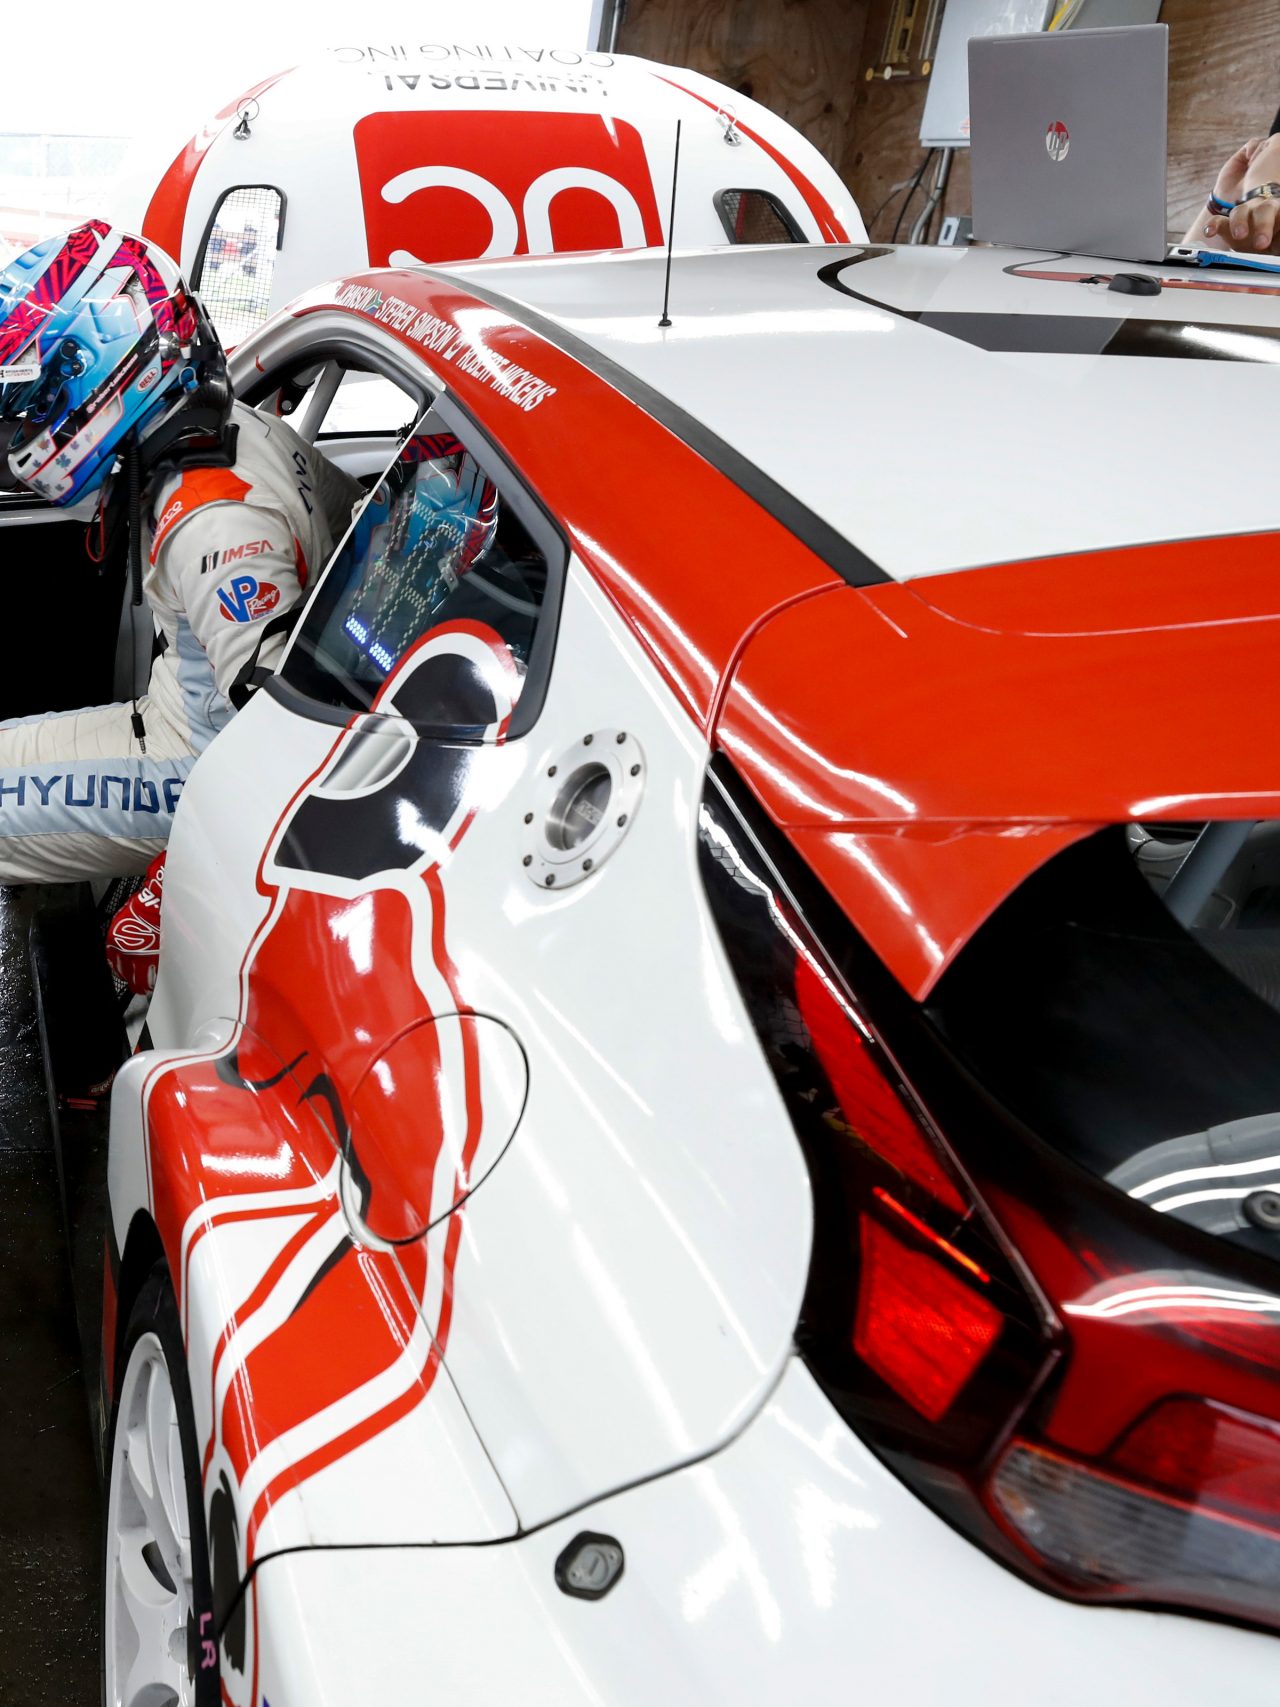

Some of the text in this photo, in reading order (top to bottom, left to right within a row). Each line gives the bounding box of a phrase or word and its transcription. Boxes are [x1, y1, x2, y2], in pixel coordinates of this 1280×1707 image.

[419, 45, 615, 67] COATING
[1047, 120, 1069, 161] hp
[374, 296, 418, 332] STEPHEN
[406, 312, 460, 354] SIMPSON
[455, 343, 509, 383] ROBERT
[489, 362, 557, 411] WICKENS
[139, 370, 156, 390] BELL
[222, 539, 275, 565] IMSA
[216, 576, 258, 623] VP
[249, 589, 280, 614] Racing
